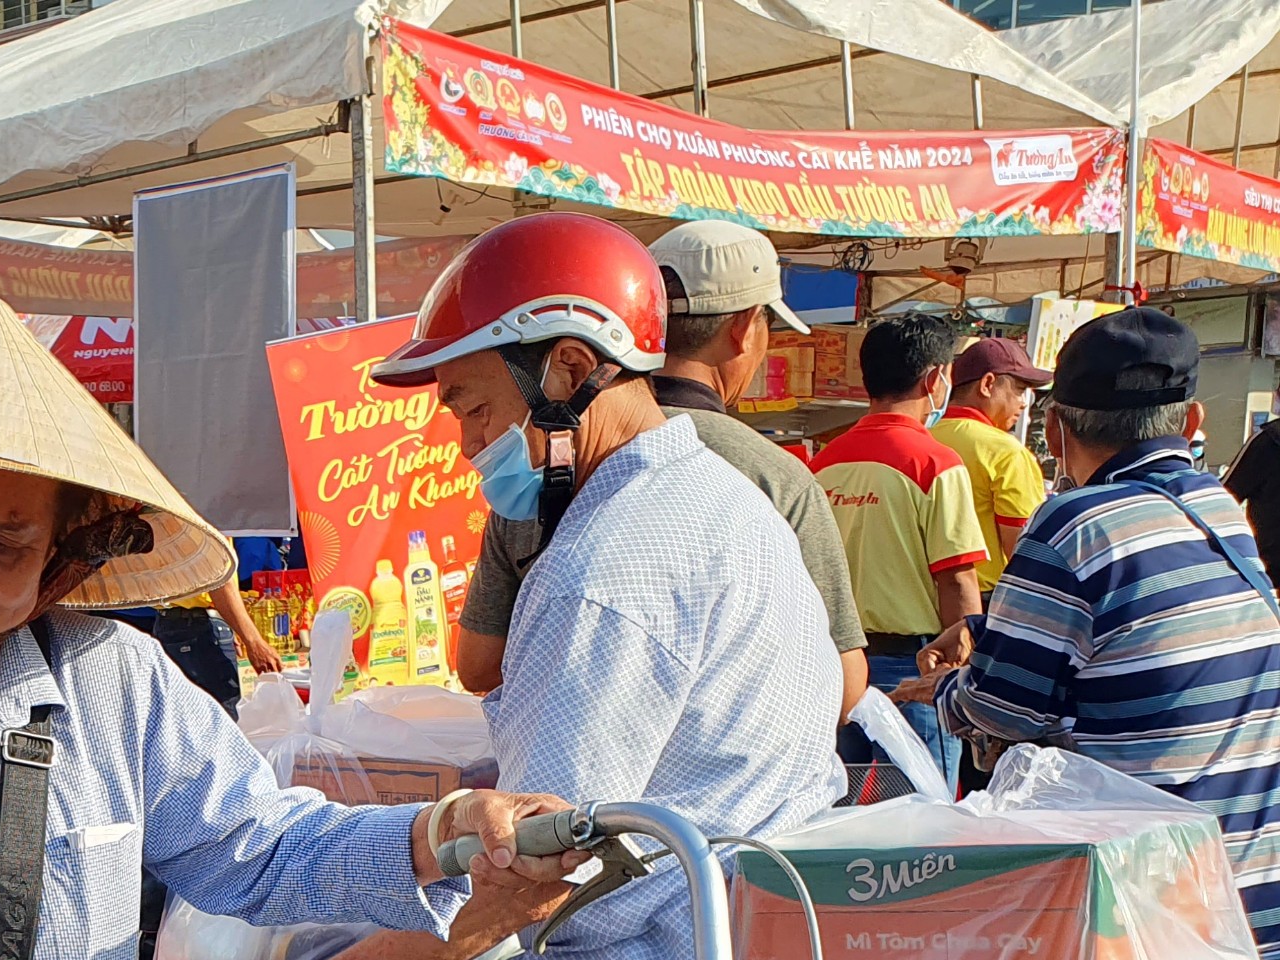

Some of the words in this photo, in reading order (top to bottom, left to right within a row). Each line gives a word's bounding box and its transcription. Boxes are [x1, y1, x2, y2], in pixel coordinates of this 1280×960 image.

[580, 103, 633, 138] PHIÊN
[636, 119, 672, 151] CHỢ
[676, 132, 721, 160] XUÂN
[722, 141, 795, 170] PHƯỜNG
[798, 144, 831, 170] CÁI
[834, 141, 874, 171] KHẾ
[879, 144, 921, 169] NĂM
[926, 146, 973, 167] 2024
[1017, 149, 1057, 170] Tường
[620, 147, 664, 199] TẬP
[667, 162, 736, 213] ĐOÀN
[732, 175, 787, 218] KIDO
[784, 170, 839, 222] DẦU
[834, 176, 918, 223] TƯỜNG
[920, 183, 958, 222] AN
[100, 381, 125, 392] 6800
[300, 391, 440, 441] Tường
[318, 454, 373, 502] Cát
[377, 433, 462, 484] Tường
[347, 484, 401, 527] An
[408, 470, 483, 509] Khang
[847, 932, 870, 950] Mì
[877, 932, 925, 949] Tôm
